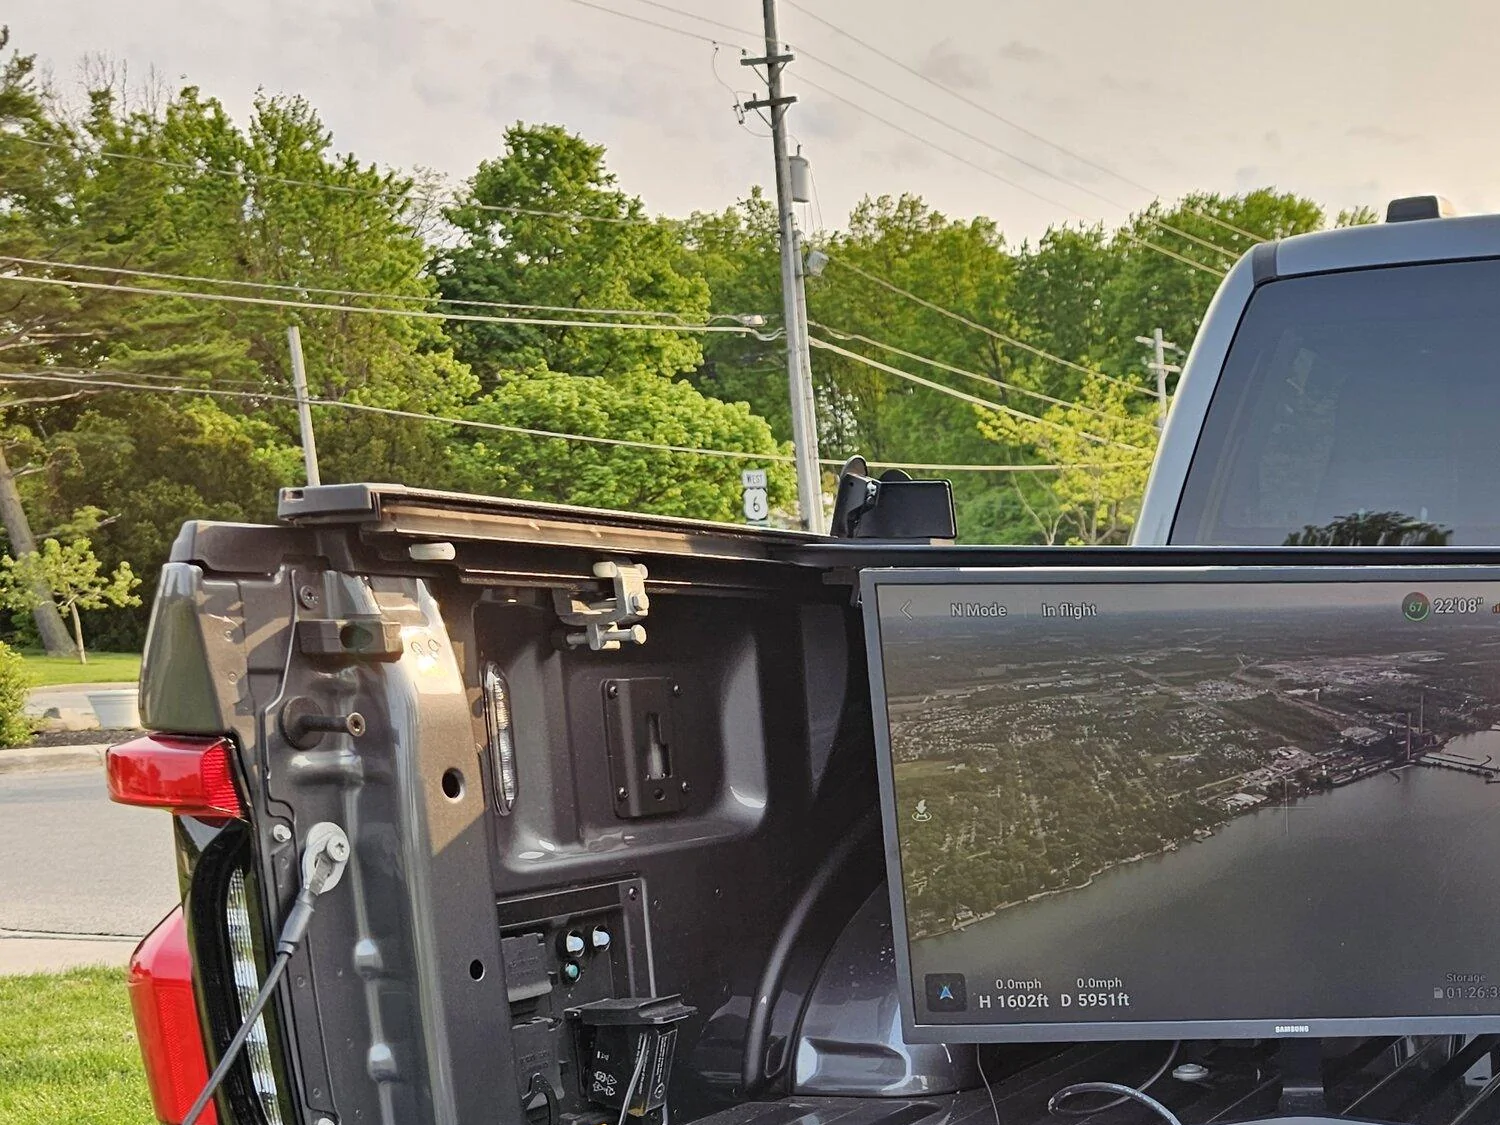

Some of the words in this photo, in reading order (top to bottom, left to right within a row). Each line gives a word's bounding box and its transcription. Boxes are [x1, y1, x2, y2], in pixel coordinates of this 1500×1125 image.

[746, 474, 763, 485] WEST
[753, 496, 761, 513] 6
[951, 603, 961, 617] N
[966, 603, 1008, 618] Mode
[1042, 603, 1056, 617] In
[1059, 603, 1097, 620] flight
[1408, 601, 1424, 613] 67
[995, 978, 1042, 991] 0.0mph
[1076, 977, 1123, 990] 0.0mph
[1446, 973, 1487, 985] Storage
[979, 995, 991, 1008] H
[998, 994, 1050, 1008] 1602ft
[1061, 994, 1072, 1007] D
[1078, 993, 1130, 1008] 5951ft
[1275, 1025, 1310, 1034] SAMSUNG
